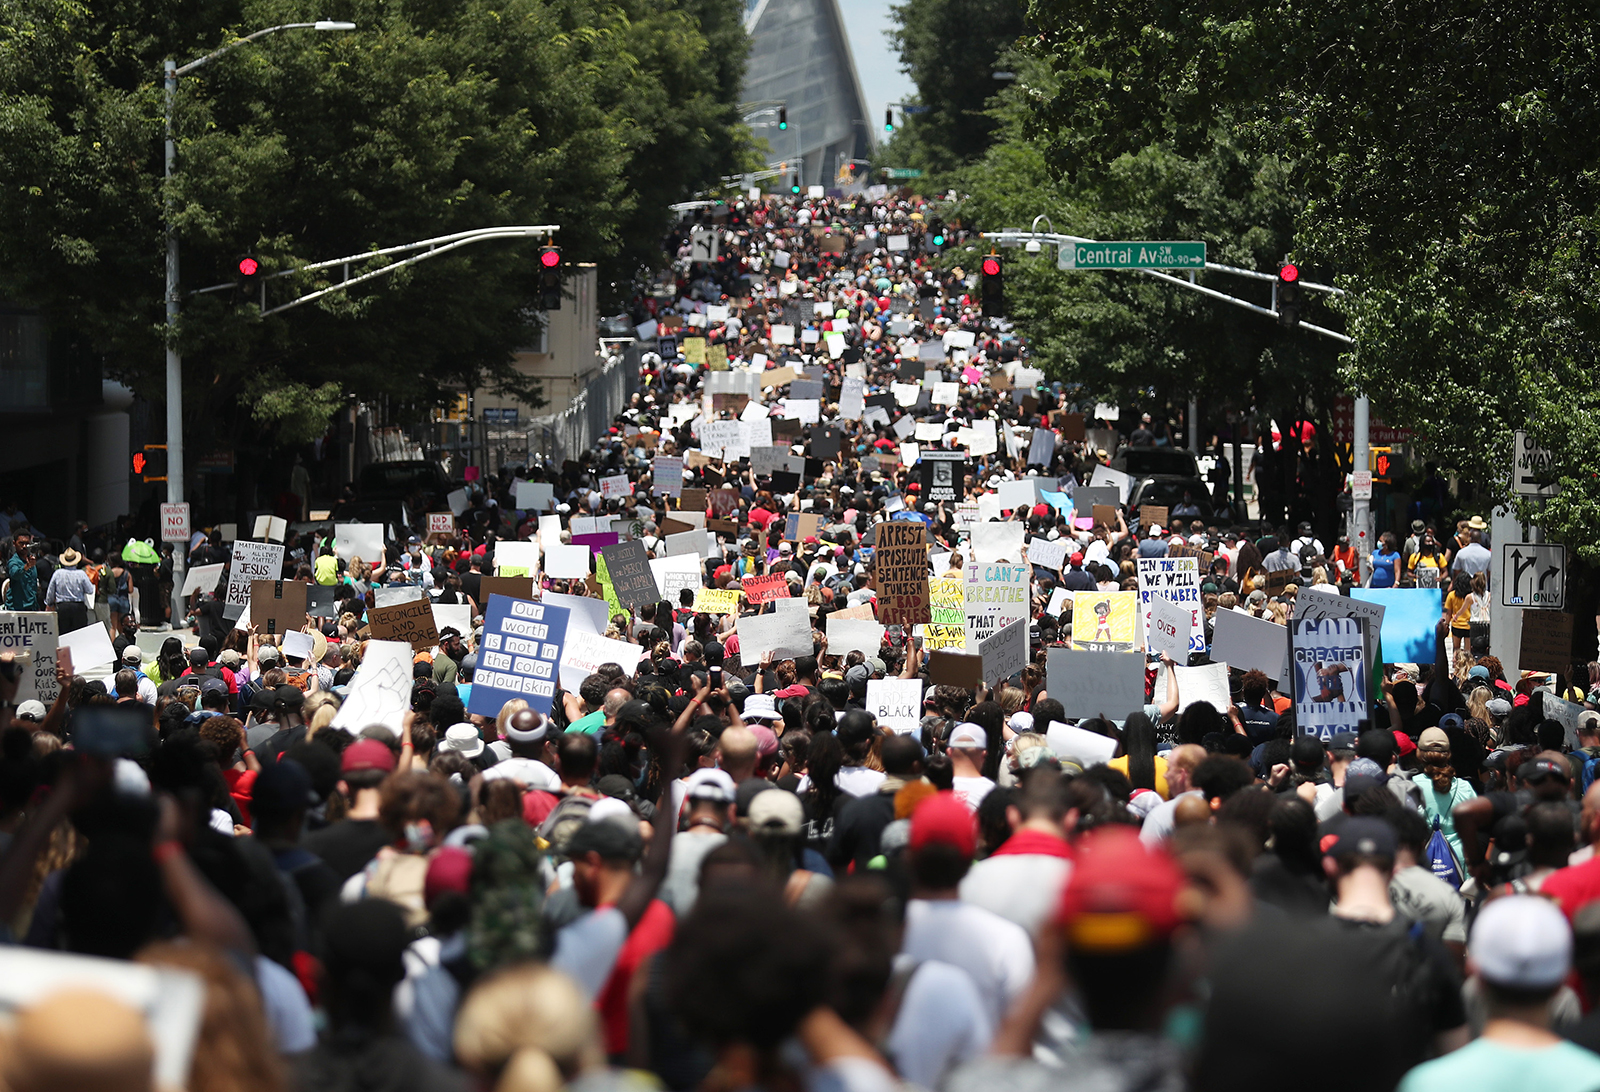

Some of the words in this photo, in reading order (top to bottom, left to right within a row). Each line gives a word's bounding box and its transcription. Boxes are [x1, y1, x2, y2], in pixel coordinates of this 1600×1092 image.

[1077, 247, 1131, 264] Central
[1138, 247, 1157, 264] Av
[1159, 255, 1189, 264] 140-90
[1160, 246, 1171, 254] SW
[168, 517, 183, 526] NO
[432, 516, 448, 524] END
[165, 528, 187, 538] PARKING
[879, 525, 924, 548] ARREST
[617, 547, 636, 559] JUSTLY
[878, 548, 926, 567] PROSECUTE
[622, 561, 644, 575] MERCY
[1140, 560, 1156, 572] IN
[1160, 560, 1175, 572] THE
[743, 579, 755, 587] NO
[754, 574, 786, 584] JUSTICE
[879, 567, 926, 583] SENTENCE
[969, 566, 979, 583] I
[985, 565, 1026, 583] CAN'T
[1144, 574, 1162, 586] WE
[1165, 573, 1194, 586] WILL
[229, 583, 251, 594] BLAC
[705, 590, 733, 599] UNITED
[747, 593, 760, 601] NO
[760, 586, 789, 600] PEACE
[884, 582, 922, 595] PUNISH
[940, 581, 963, 596] DON
[966, 586, 1025, 603] BREATHE
[228, 594, 250, 605] MAT
[636, 592, 651, 602] 6:8
[879, 596, 891, 605] THE
[373, 603, 431, 626] RECONCILE
[515, 603, 541, 618] Our
[697, 604, 731, 612] RACISM
[392, 620, 415, 634] AND
[967, 615, 995, 629] THAT
[1156, 619, 1177, 638] OVER
[505, 622, 546, 637] worth
[928, 624, 944, 637] WE
[945, 626, 965, 638] WAN
[1297, 618, 1359, 650] GOD
[488, 635, 499, 648] is
[508, 640, 532, 653] not
[542, 644, 555, 657] in
[578, 632, 598, 647] THIS
[617, 644, 637, 656] NOT
[924, 637, 964, 650] JUSTIC
[982, 625, 1018, 656] ENOUGH
[33, 651, 53, 668] for
[996, 651, 1006, 660] IS
[1295, 649, 1362, 663] CREATED
[487, 654, 510, 669] the
[515, 661, 551, 676] color
[567, 657, 600, 672] MOVEM
[35, 667, 57, 677] OUR
[35, 679, 57, 689] Kid's
[476, 672, 492, 684] of
[496, 677, 520, 688] our
[524, 680, 551, 695] skin
[881, 681, 909, 691] END
[868, 691, 919, 705] MURDER
[879, 705, 915, 718] BLACK
